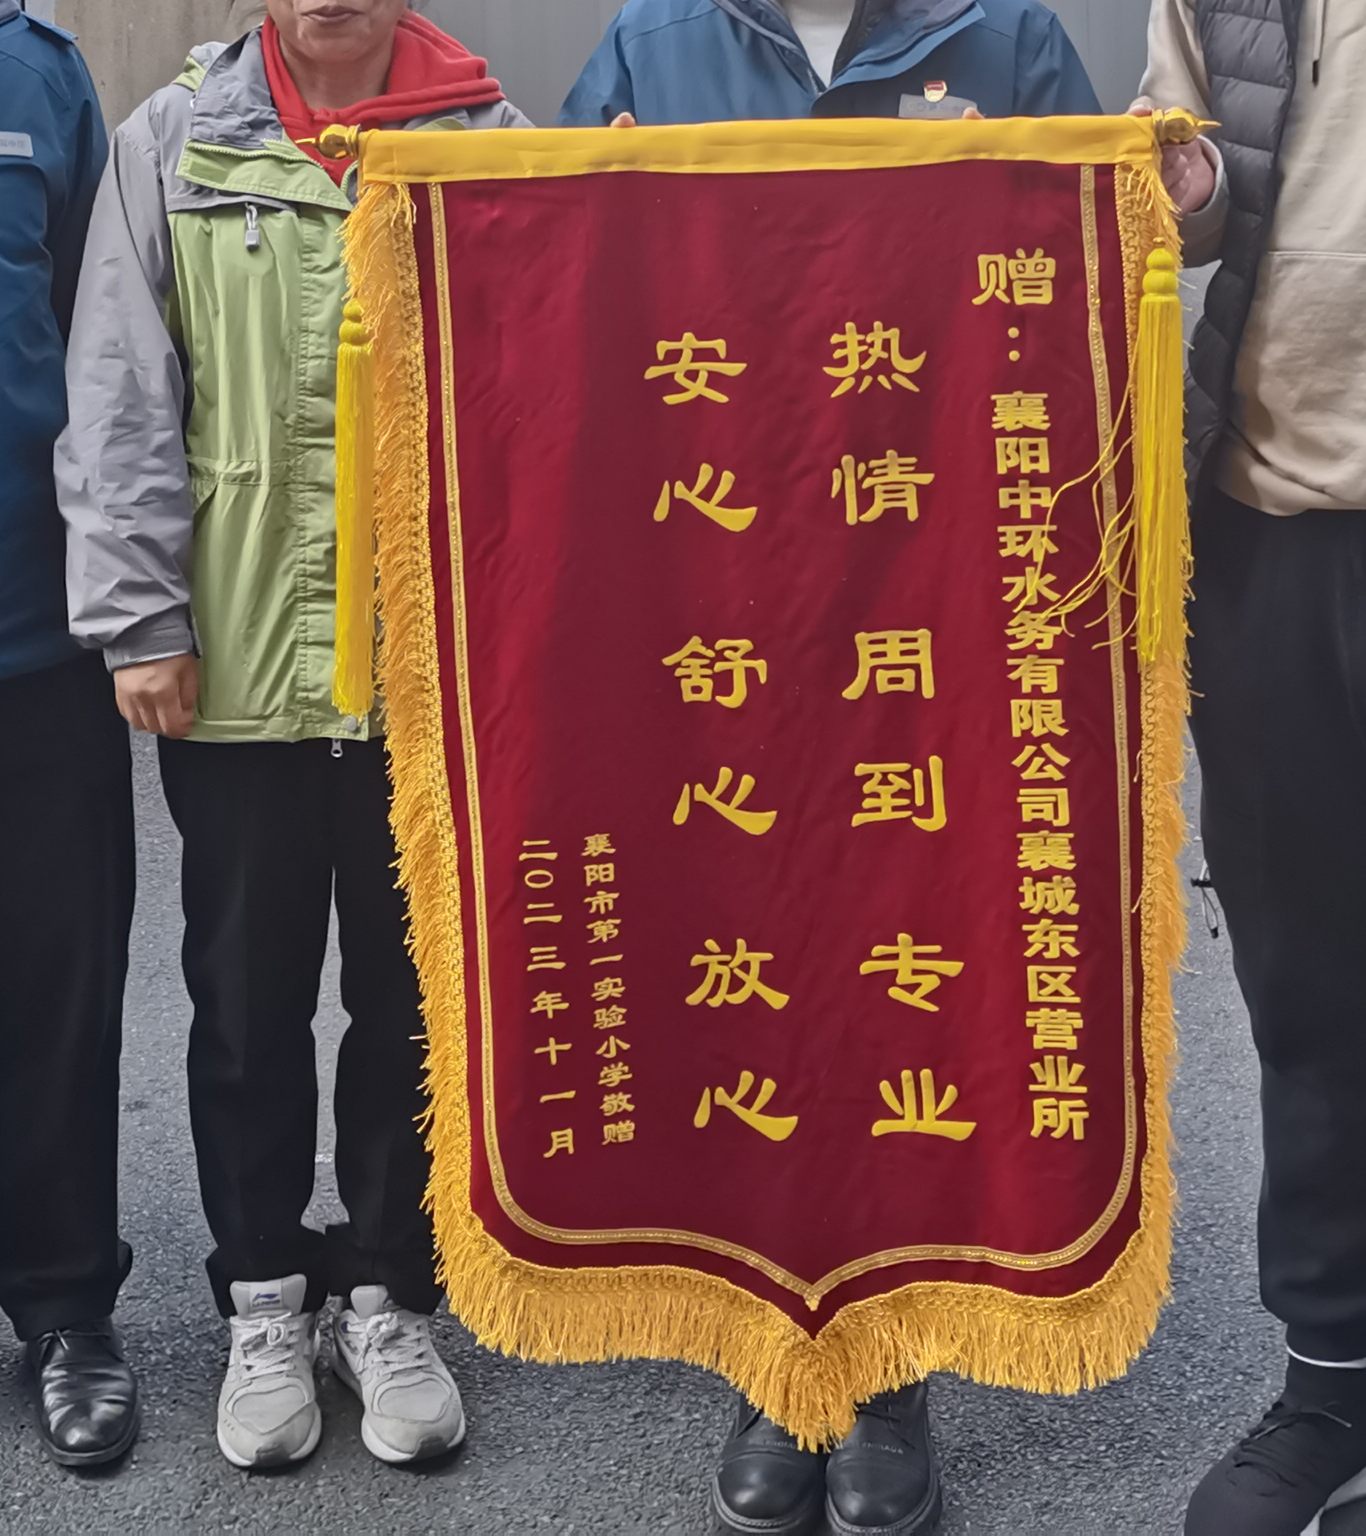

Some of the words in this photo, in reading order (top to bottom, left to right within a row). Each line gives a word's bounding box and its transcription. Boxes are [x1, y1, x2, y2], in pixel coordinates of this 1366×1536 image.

[581, 833, 636, 1146] 襄阳市第一实验小学敬赠
